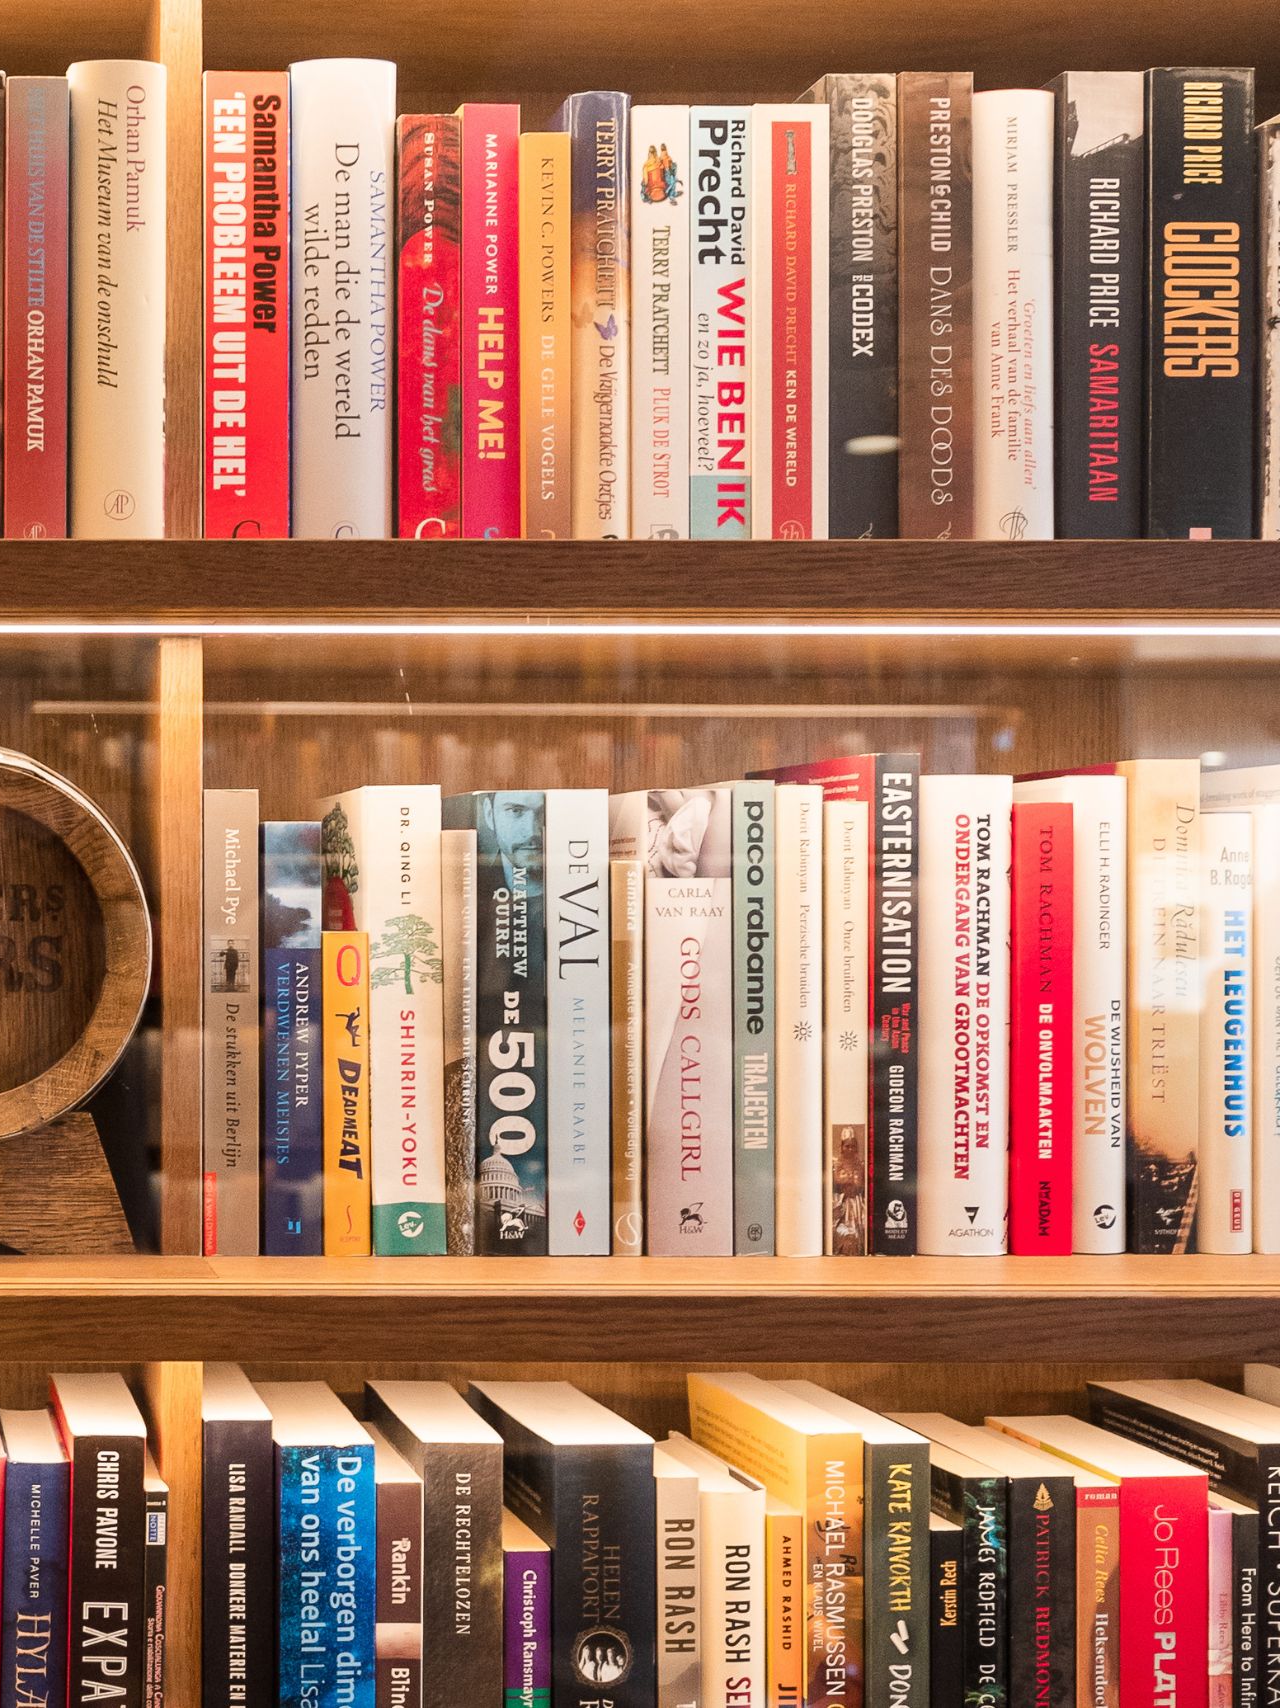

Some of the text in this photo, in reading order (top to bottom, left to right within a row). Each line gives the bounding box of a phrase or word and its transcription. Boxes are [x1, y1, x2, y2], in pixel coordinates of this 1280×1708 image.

[698, 119, 728, 265] Precht
[731, 119, 746, 265] Richard David
[1007, 116, 1017, 253] MIRJAM PRESSLER
[1183, 82, 1222, 184] RICHARD PRICE
[212, 162, 246, 322] PROBLEEM
[253, 95, 281, 333] Samantha Power
[852, 97, 873, 357] DOUGLAS PRESTON CODEX
[212, 330, 246, 383] UIT
[478, 133, 506, 460] MARIANNE POWER HELP ME!
[1164, 222, 1239, 377] CLOCKERS
[212, 391, 246, 428] DE
[717, 278, 746, 527] WIE BEN IK
[400, 807, 410, 905] DR. QING LI
[495, 888, 510, 958] QUIRK
[512, 866, 528, 977] MATTHEW
[655, 906, 724, 917] VAN RAAY
[668, 887, 712, 899] CARLA
[744, 800, 770, 1035] paco rabanne
[882, 772, 912, 993] EASTERNISATION
[955, 815, 971, 1179] ONDERGANG VAN GROOTMACHTEN
[976, 815, 990, 1149] TOM RACHMAN DE OPKOMST EN
[1224, 911, 1246, 1138] HET LEUGENHUIS
[400, 1010, 417, 1186] SHINRIN-YOKU
[488, 991, 536, 1155] DE 500
[679, 936, 702, 1181] GODS CALLGIRL
[741, 1052, 768, 1150] TRAJECTEN
[889, 1065, 904, 1181] GIDEON RACHMAN
[1084, 1014, 1106, 1135] WOLVEN
[949, 1228, 994, 1237] AGATHON
[1233, 1191, 1241, 1230] DE GEUS
[30, 1484, 40, 1599] MICHELLE PAVER
[96, 1450, 120, 1570] CHRIS PAVONE
[301, 1455, 326, 1653] van ons heelal
[329, 1456, 362, 1642] De verborgen
[455, 1473, 471, 1635] DE RECHTELOZEN
[1085, 1492, 1117, 1500] roman
[726, 1544, 750, 1663] RON RASH
[781, 1536, 791, 1651] AHMED RASHID
[825, 1460, 845, 1696] MICHAEL RASMUSSEN
[940, 1560, 957, 1584] Rech
[1154, 1505, 1179, 1625] Jo Rees
[520, 1570, 537, 1706] Christoph Ransmayr
